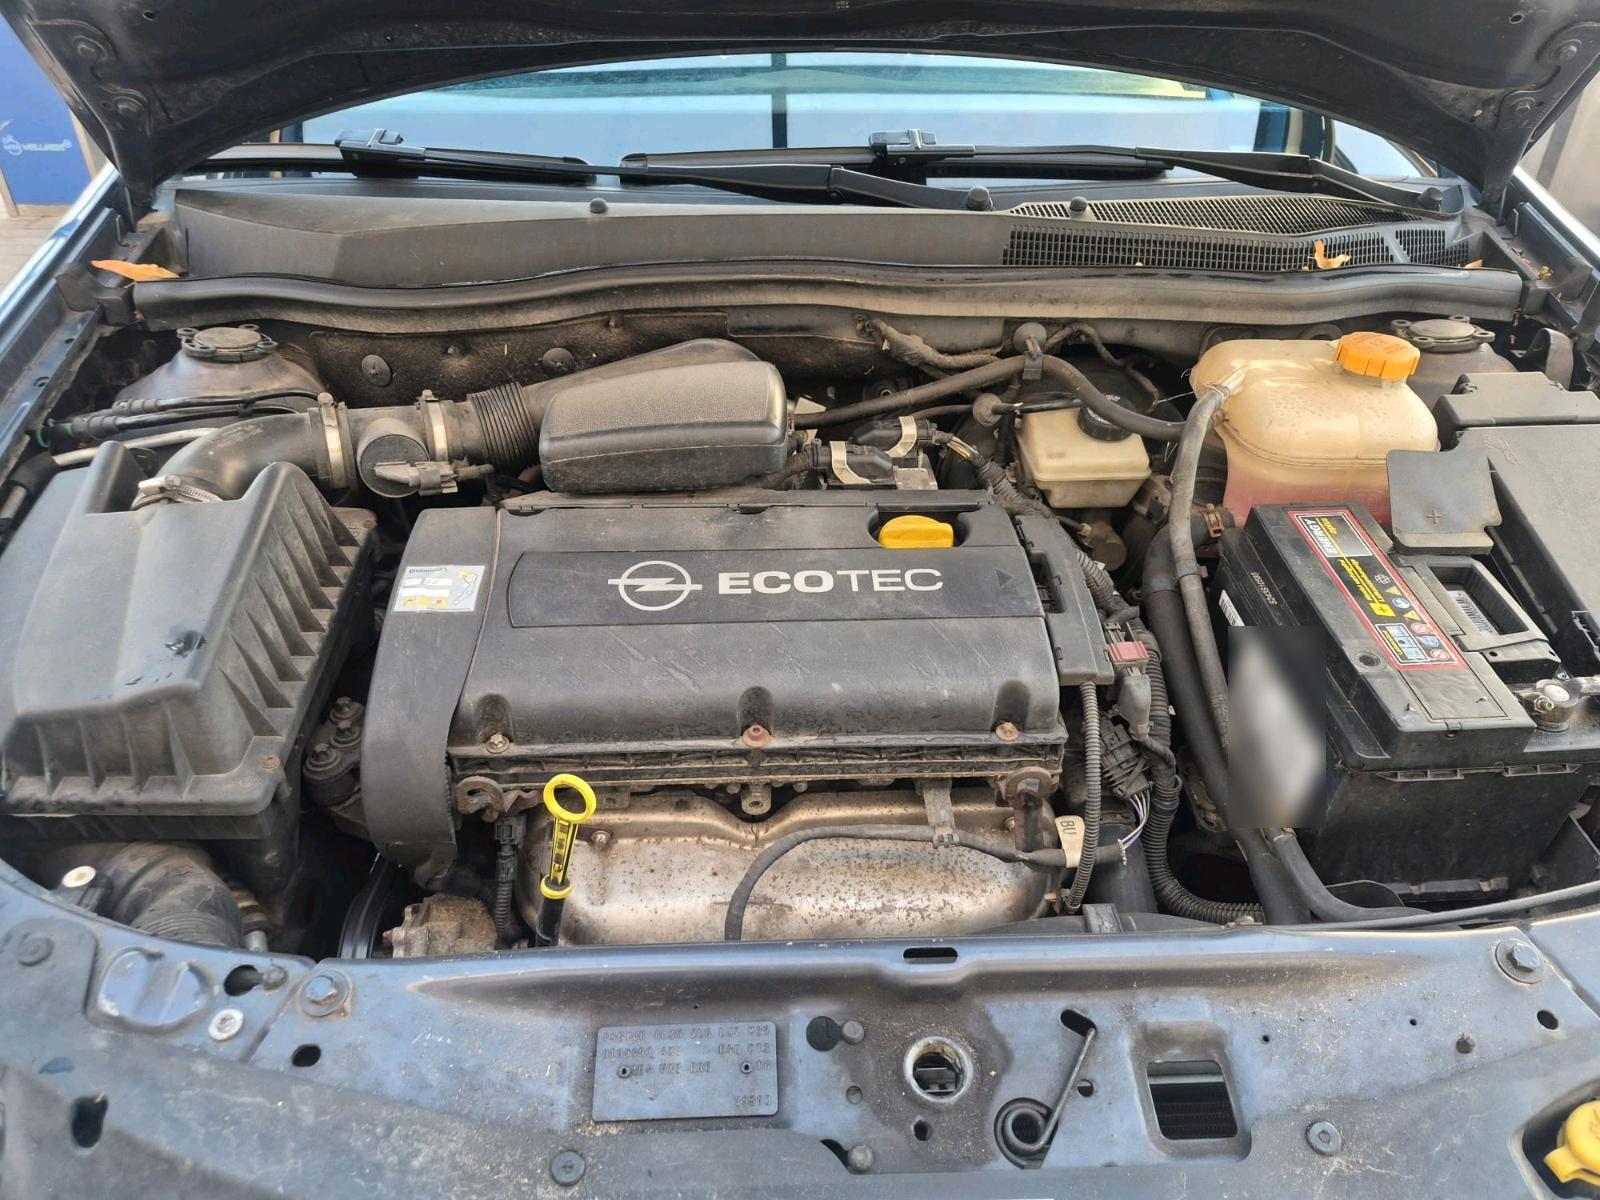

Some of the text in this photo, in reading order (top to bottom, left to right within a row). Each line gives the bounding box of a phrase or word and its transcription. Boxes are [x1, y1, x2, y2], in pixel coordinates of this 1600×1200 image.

[1303, 518, 1339, 554] ENERGY
[718, 568, 944, 595] ECOTEC
[1060, 821, 1076, 834] BU
